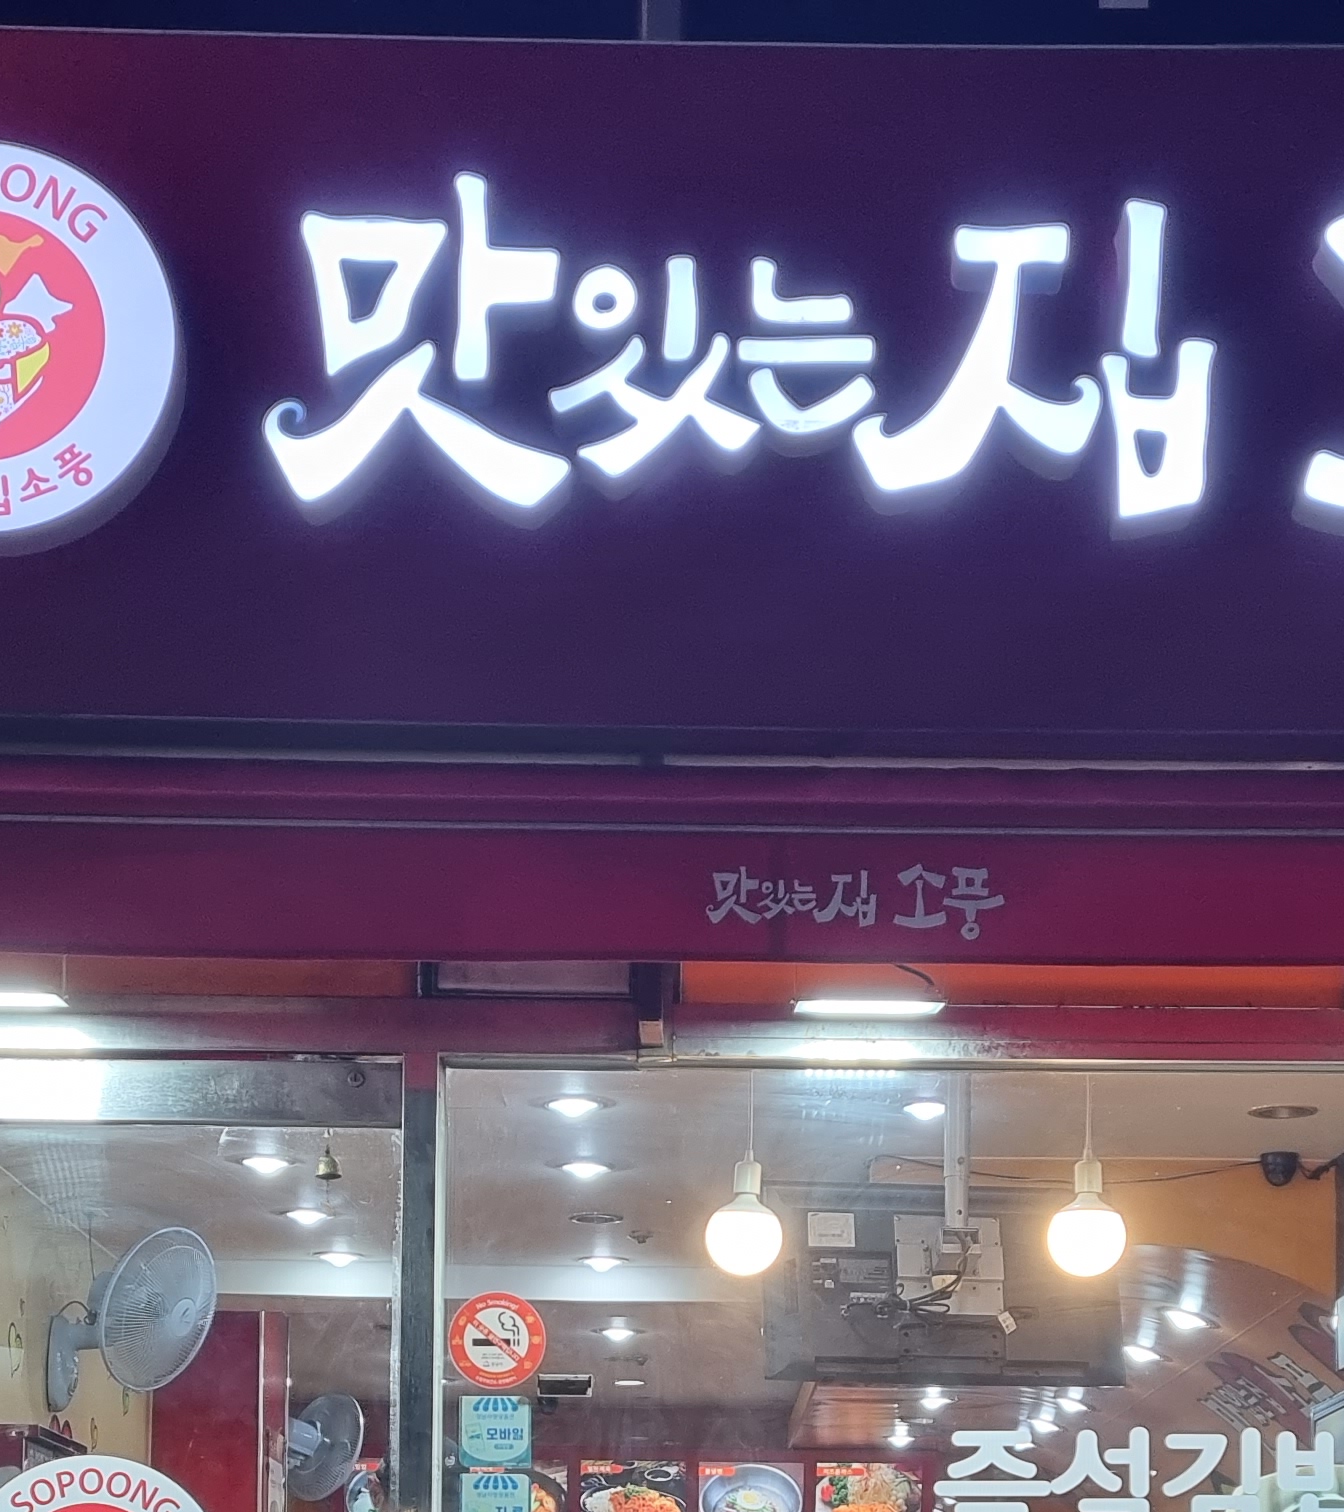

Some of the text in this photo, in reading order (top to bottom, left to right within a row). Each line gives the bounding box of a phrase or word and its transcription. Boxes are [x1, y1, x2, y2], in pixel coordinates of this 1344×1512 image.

[261, 170, 1218, 519] 맛있는집
[705, 863, 1006, 941] 맛있는집 소풍
[486, 1427, 524, 1441] 모바일
